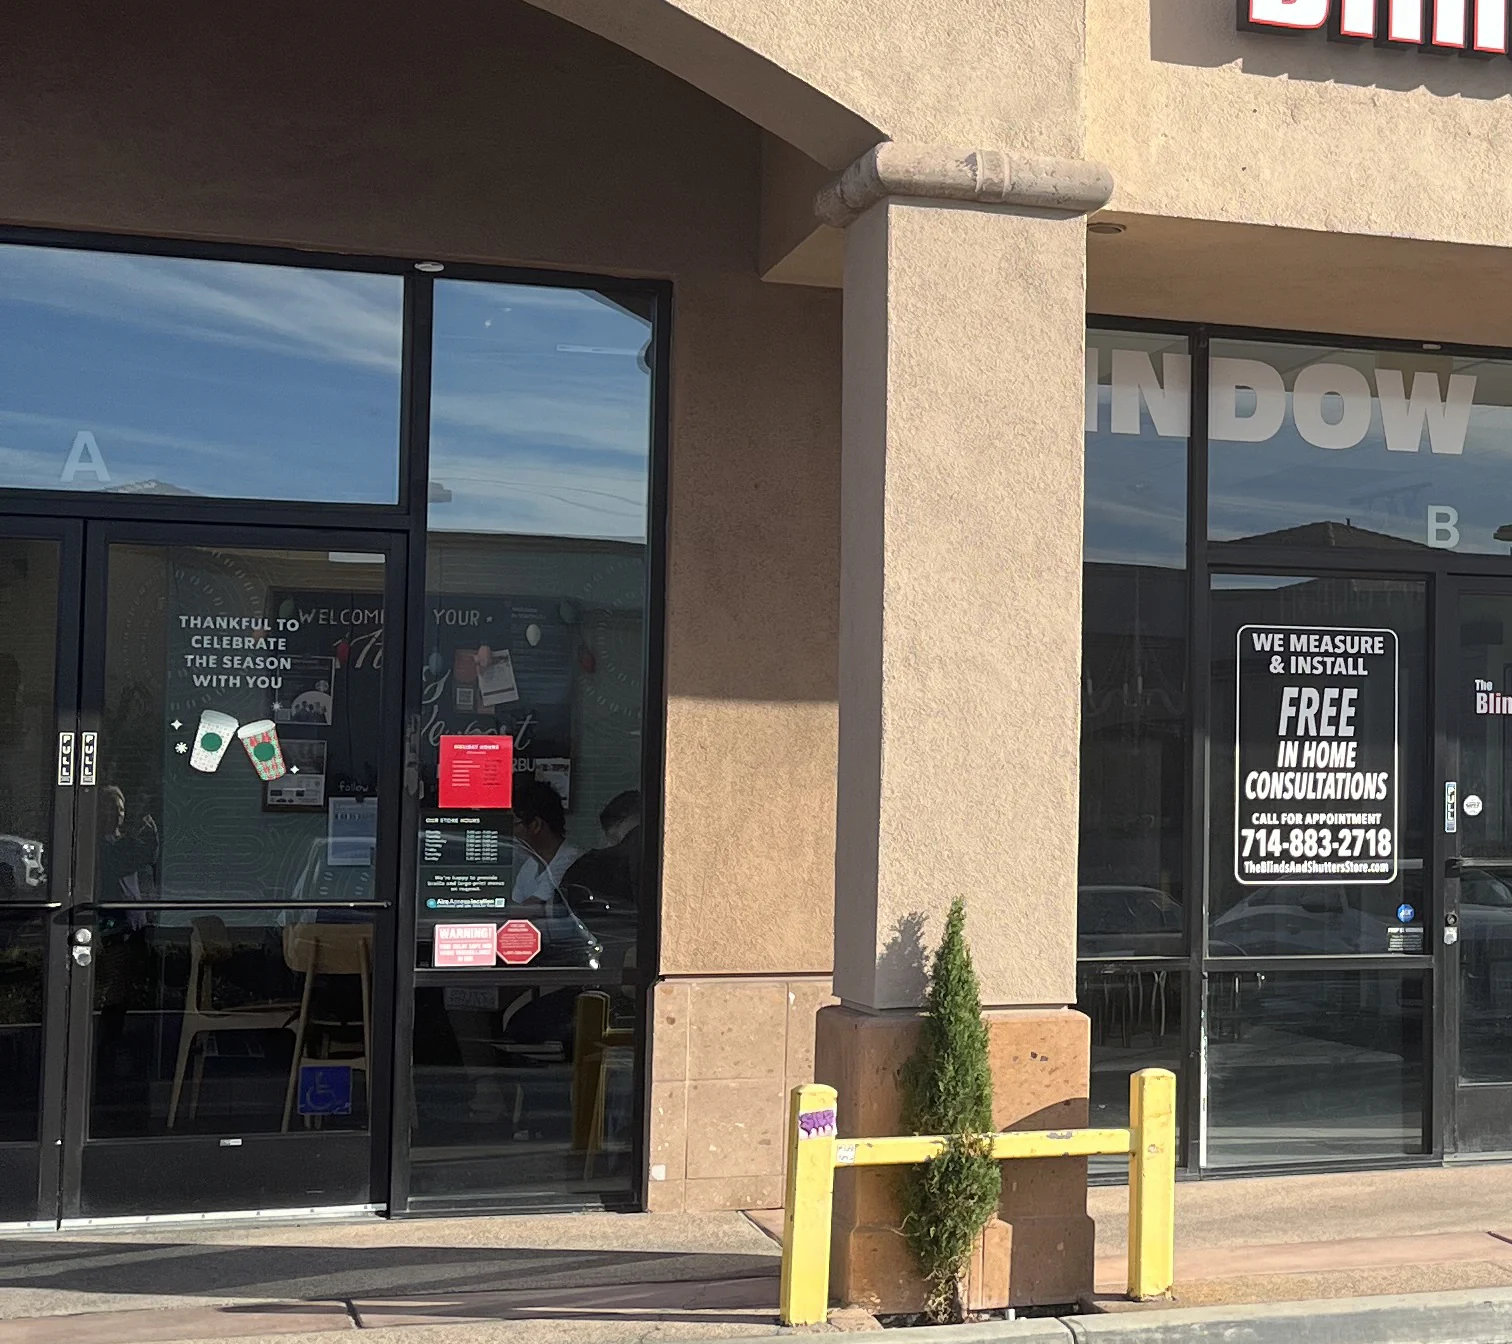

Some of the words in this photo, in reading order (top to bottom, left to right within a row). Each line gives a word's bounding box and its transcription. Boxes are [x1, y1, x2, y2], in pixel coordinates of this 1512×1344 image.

[59, 430, 111, 483] A
[1427, 504, 1460, 549] B
[179, 615, 272, 631] THANKFUL
[276, 618, 300, 632] TO
[432, 609, 481, 626] YOUR
[191, 635, 287, 650] CELEBRATE
[1252, 632, 1284, 652] WE
[1289, 634, 1385, 654] MEASURE
[184, 654, 218, 668] THE
[222, 655, 292, 670] SEASON
[1269, 654, 1285, 674] &
[1290, 656, 1368, 675] INSTALL
[192, 674, 240, 688] WITH
[245, 675, 283, 689] YOU
[1475, 679, 1493, 691] The
[1278, 686, 1358, 737] FREE
[62, 735, 71, 776] PULL
[84, 735, 94, 776] PULL
[1277, 740, 1299, 768] IN
[1302, 740, 1358, 768] HOME
[1245, 770, 1389, 800] CONSULTATIONS
[1251, 812, 1280, 825] CALL
[1280, 812, 1303, 825] FOR
[1304, 812, 1382, 825] APPOINTMENT
[1241, 828, 1392, 858] 714-883-2718
[439, 927, 493, 939] WARNING!
